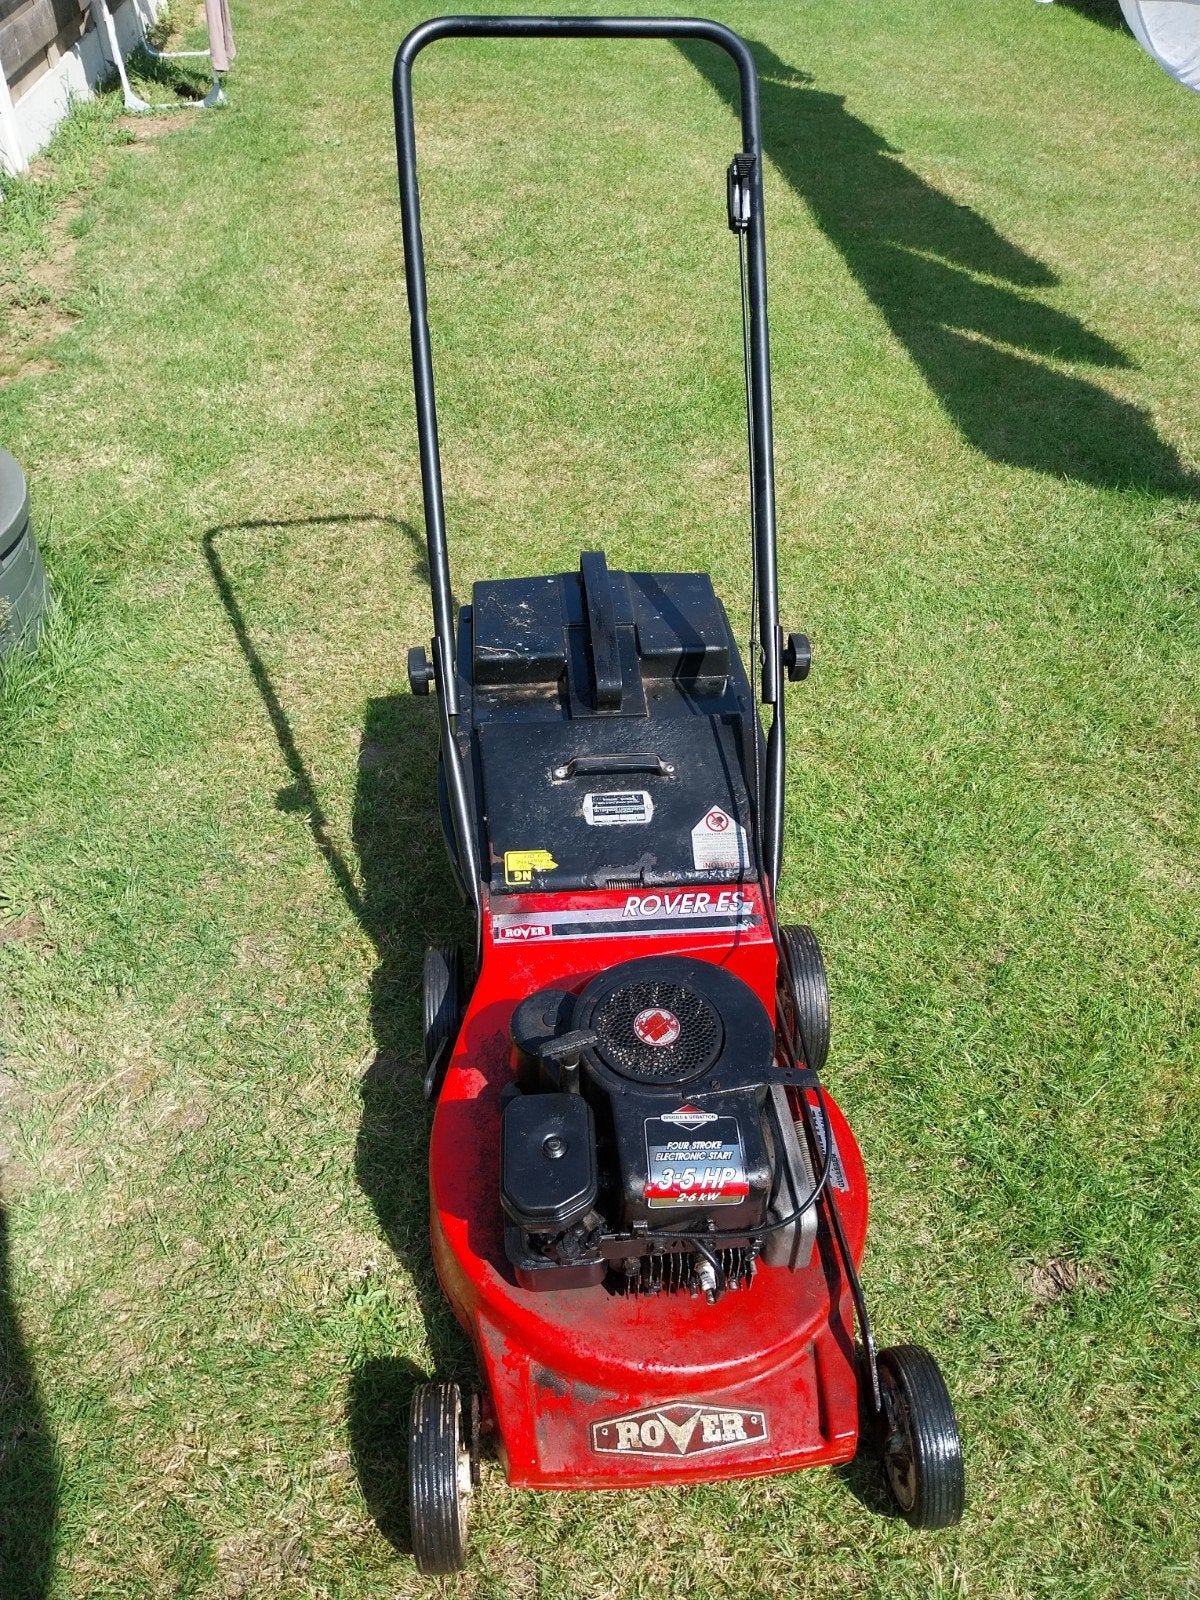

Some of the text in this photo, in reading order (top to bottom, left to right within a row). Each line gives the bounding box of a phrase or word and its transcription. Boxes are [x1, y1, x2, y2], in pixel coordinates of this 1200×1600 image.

[622, 891, 745, 917] ROVER ES
[505, 926, 546, 939] ROVER
[667, 1141, 722, 1150] FOUR STROKE
[655, 1151, 734, 1161] ELECTRONIC START
[700, 1166, 736, 1189] HP
[616, 1409, 747, 1454] ROVER
